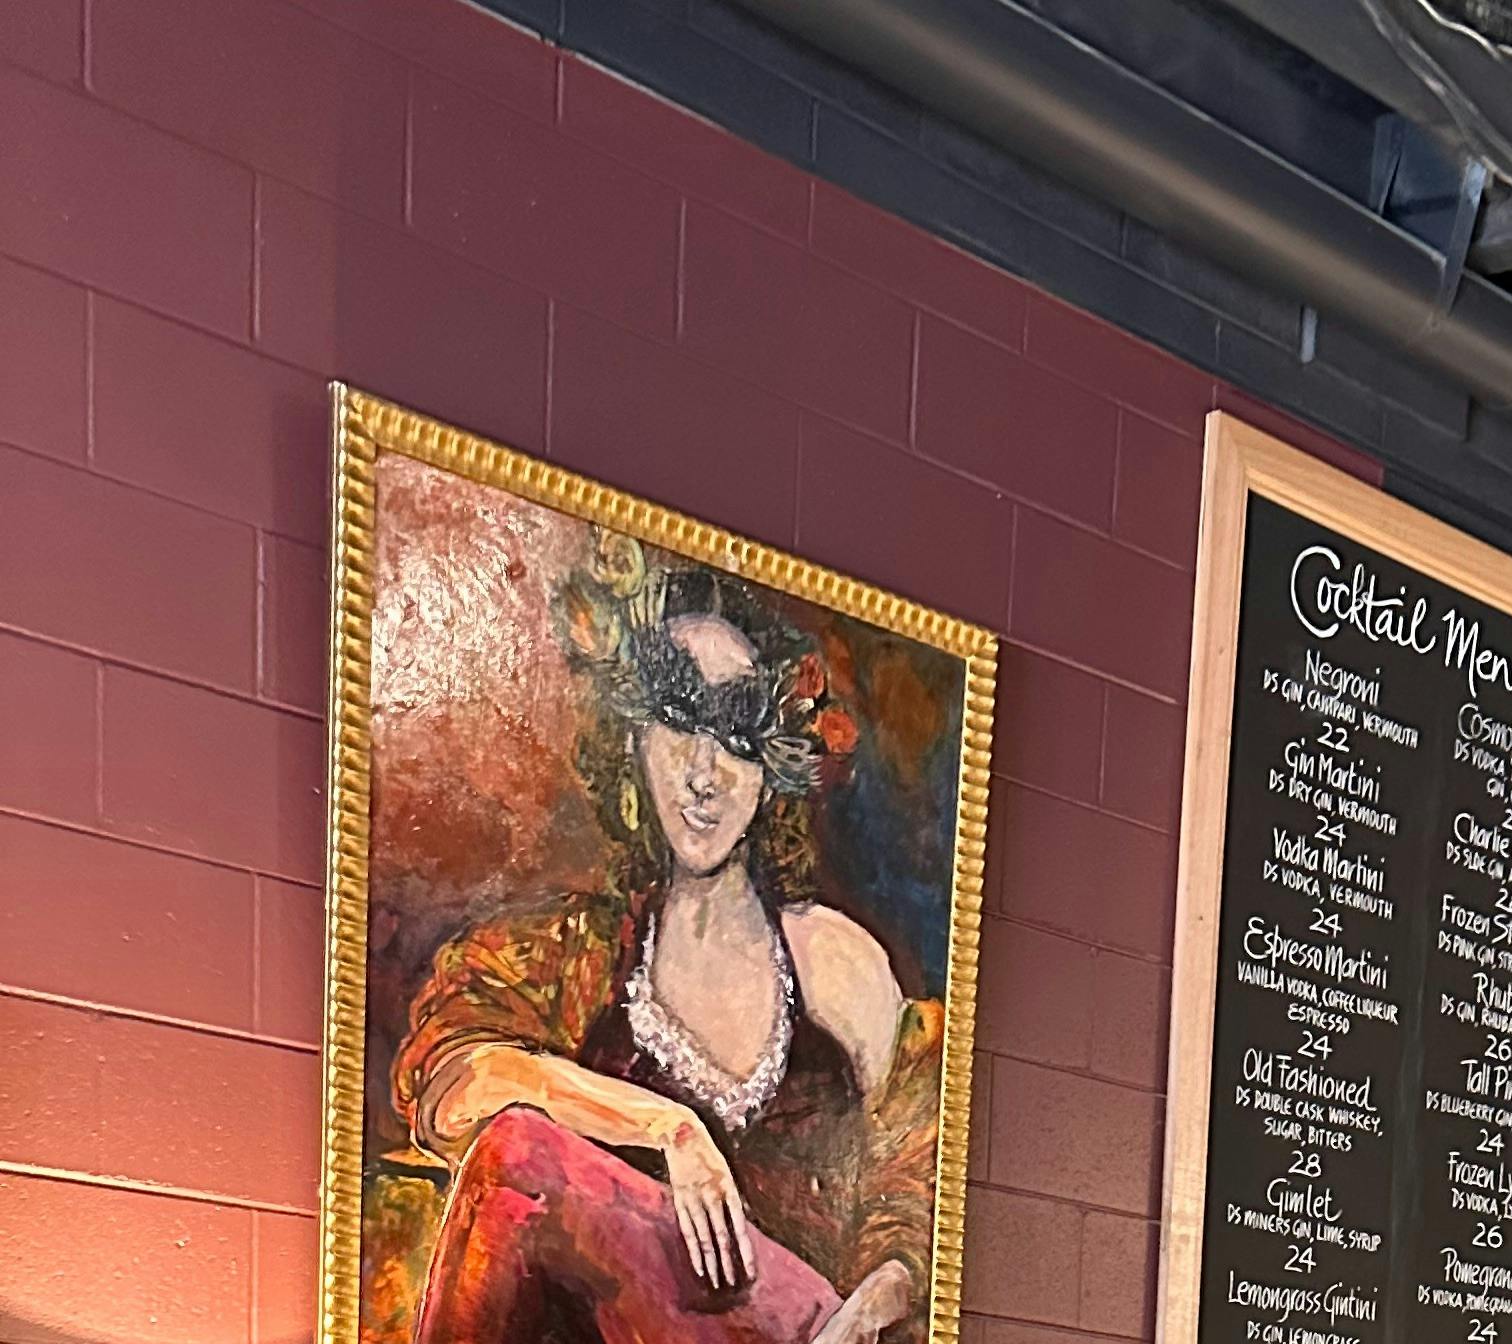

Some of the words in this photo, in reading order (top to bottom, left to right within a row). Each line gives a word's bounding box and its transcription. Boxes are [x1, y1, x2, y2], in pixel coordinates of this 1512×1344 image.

[1291, 546, 1436, 653] Cocktail
[1304, 649, 1381, 706] Negroni
[1263, 669, 1278, 692] DS
[1281, 678, 1305, 711] GIN,
[1363, 711, 1418, 748] VERMOUTH
[1317, 722, 1349, 752] 22
[1454, 739, 1470, 761] DS
[1285, 738, 1314, 778] Gin
[1319, 753, 1381, 804] Martini
[1269, 768, 1284, 792] DS
[1289, 777, 1312, 803] DRY
[1338, 797, 1397, 835] VERMOUTH
[1314, 815, 1346, 847] 24
[1454, 812, 1510, 858] Charlie
[1273, 827, 1318, 871] Vodka
[1323, 847, 1385, 892] Martini
[1446, 840, 1460, 864] DS
[1263, 860, 1279, 882] DS
[1281, 867, 1325, 904] VODKA,
[1330, 883, 1393, 920] VERMOUTH
[1309, 908, 1343, 938] 24
[1441, 894, 1490, 937] Frozen
[1244, 916, 1322, 970] Espresso
[1324, 944, 1388, 989] Martini
[1438, 930, 1452, 952] DS
[1453, 935, 1476, 961] PINK
[1237, 960, 1284, 993] VANILLA
[1287, 975, 1322, 1008] VODKA,
[1322, 987, 1356, 1013] COFFEE
[1356, 996, 1398, 1025] LIQUEUR
[1441, 994, 1454, 1015] DS
[1287, 1003, 1349, 1034] ESPRESSO
[1297, 1030, 1333, 1060] 24
[1484, 1034, 1512, 1061] 26
[1243, 1048, 1273, 1086] Old
[1275, 1055, 1377, 1111] Fashioned
[1460, 1059, 1490, 1096] Tall
[1235, 1085, 1250, 1106] DS
[1254, 1089, 1292, 1115] DOUBLE
[1295, 1100, 1323, 1122] CASK
[1329, 1106, 1383, 1136] WHISKEY,
[1426, 1091, 1440, 1110] DS
[1440, 1094, 1493, 1123] BLUEBERRY
[1264, 1117, 1306, 1146] SUGAR,
[1308, 1126, 1352, 1151] BITTERS
[1476, 1128, 1504, 1156] 24
[1288, 1150, 1321, 1177] 28
[1448, 1151, 1495, 1190] Frozen
[1266, 1177, 1343, 1221] Gimlet
[1451, 1187, 1465, 1209] DS
[1466, 1194, 1502, 1221] VODKA,
[1227, 1204, 1241, 1224] DS
[1244, 1211, 1290, 1235] MINERS
[1292, 1220, 1314, 1242] GIN,
[1317, 1223, 1348, 1249] LIME,
[1349, 1230, 1381, 1251] SYRUP
[1472, 1222, 1503, 1248] 26
[1284, 1245, 1316, 1273] 24
[1228, 1270, 1321, 1323] Lemongrass
[1324, 1282, 1378, 1326] Gintini
[1417, 1285, 1430, 1305] DS
[1247, 1321, 1260, 1339] DS
